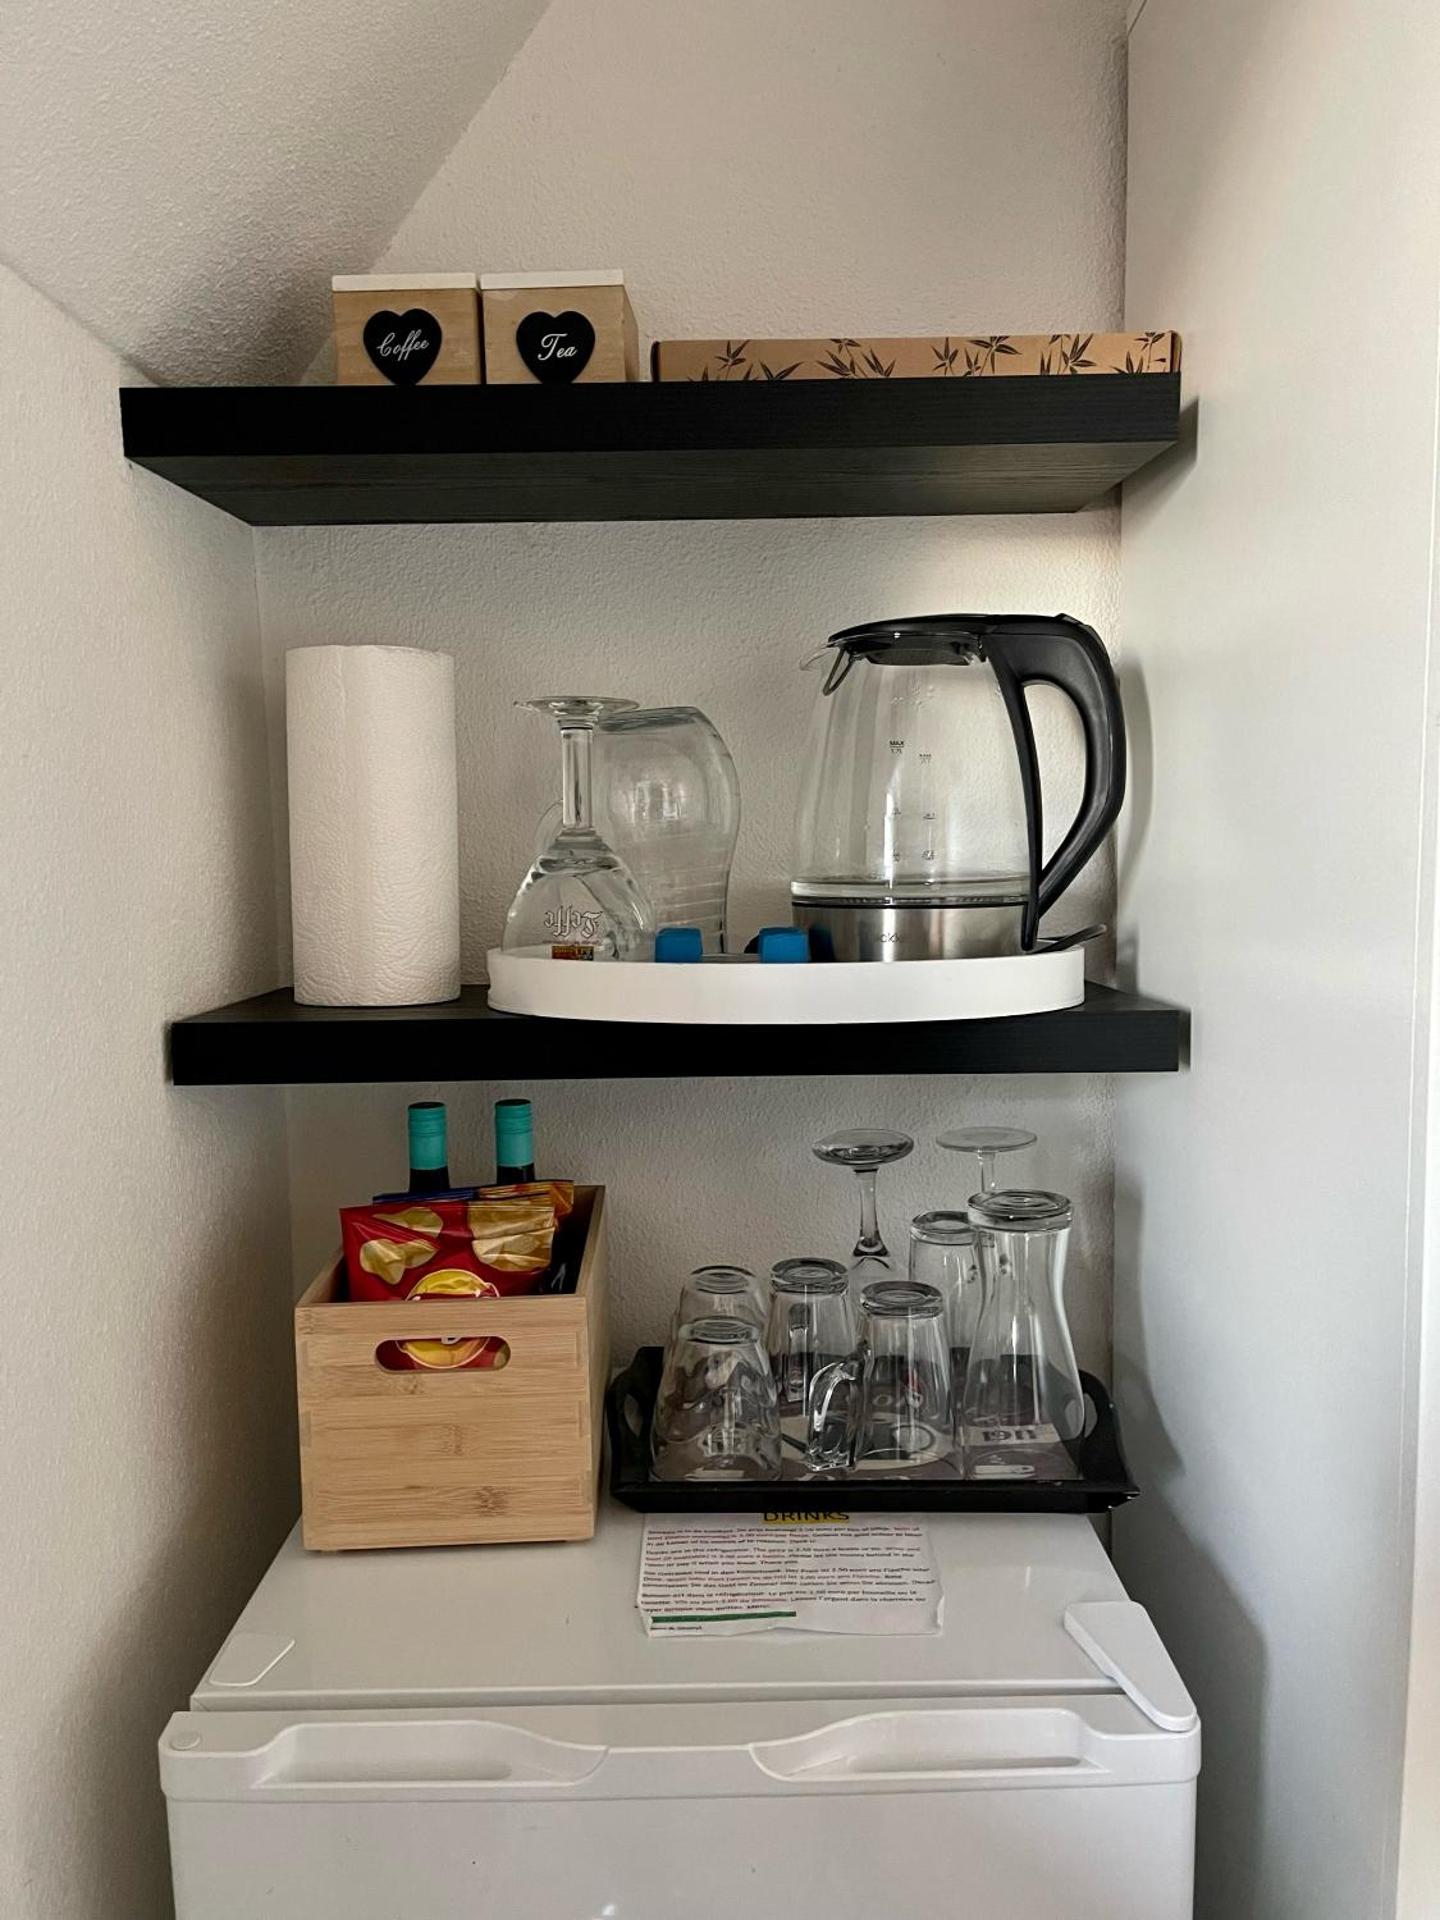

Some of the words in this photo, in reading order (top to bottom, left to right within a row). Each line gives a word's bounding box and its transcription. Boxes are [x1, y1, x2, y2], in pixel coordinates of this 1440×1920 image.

[376, 328, 430, 362] Coffee
[537, 333, 578, 361] Tea
[543, 904, 603, 938] Leffe
[763, 1512, 849, 1522] DRINKS
